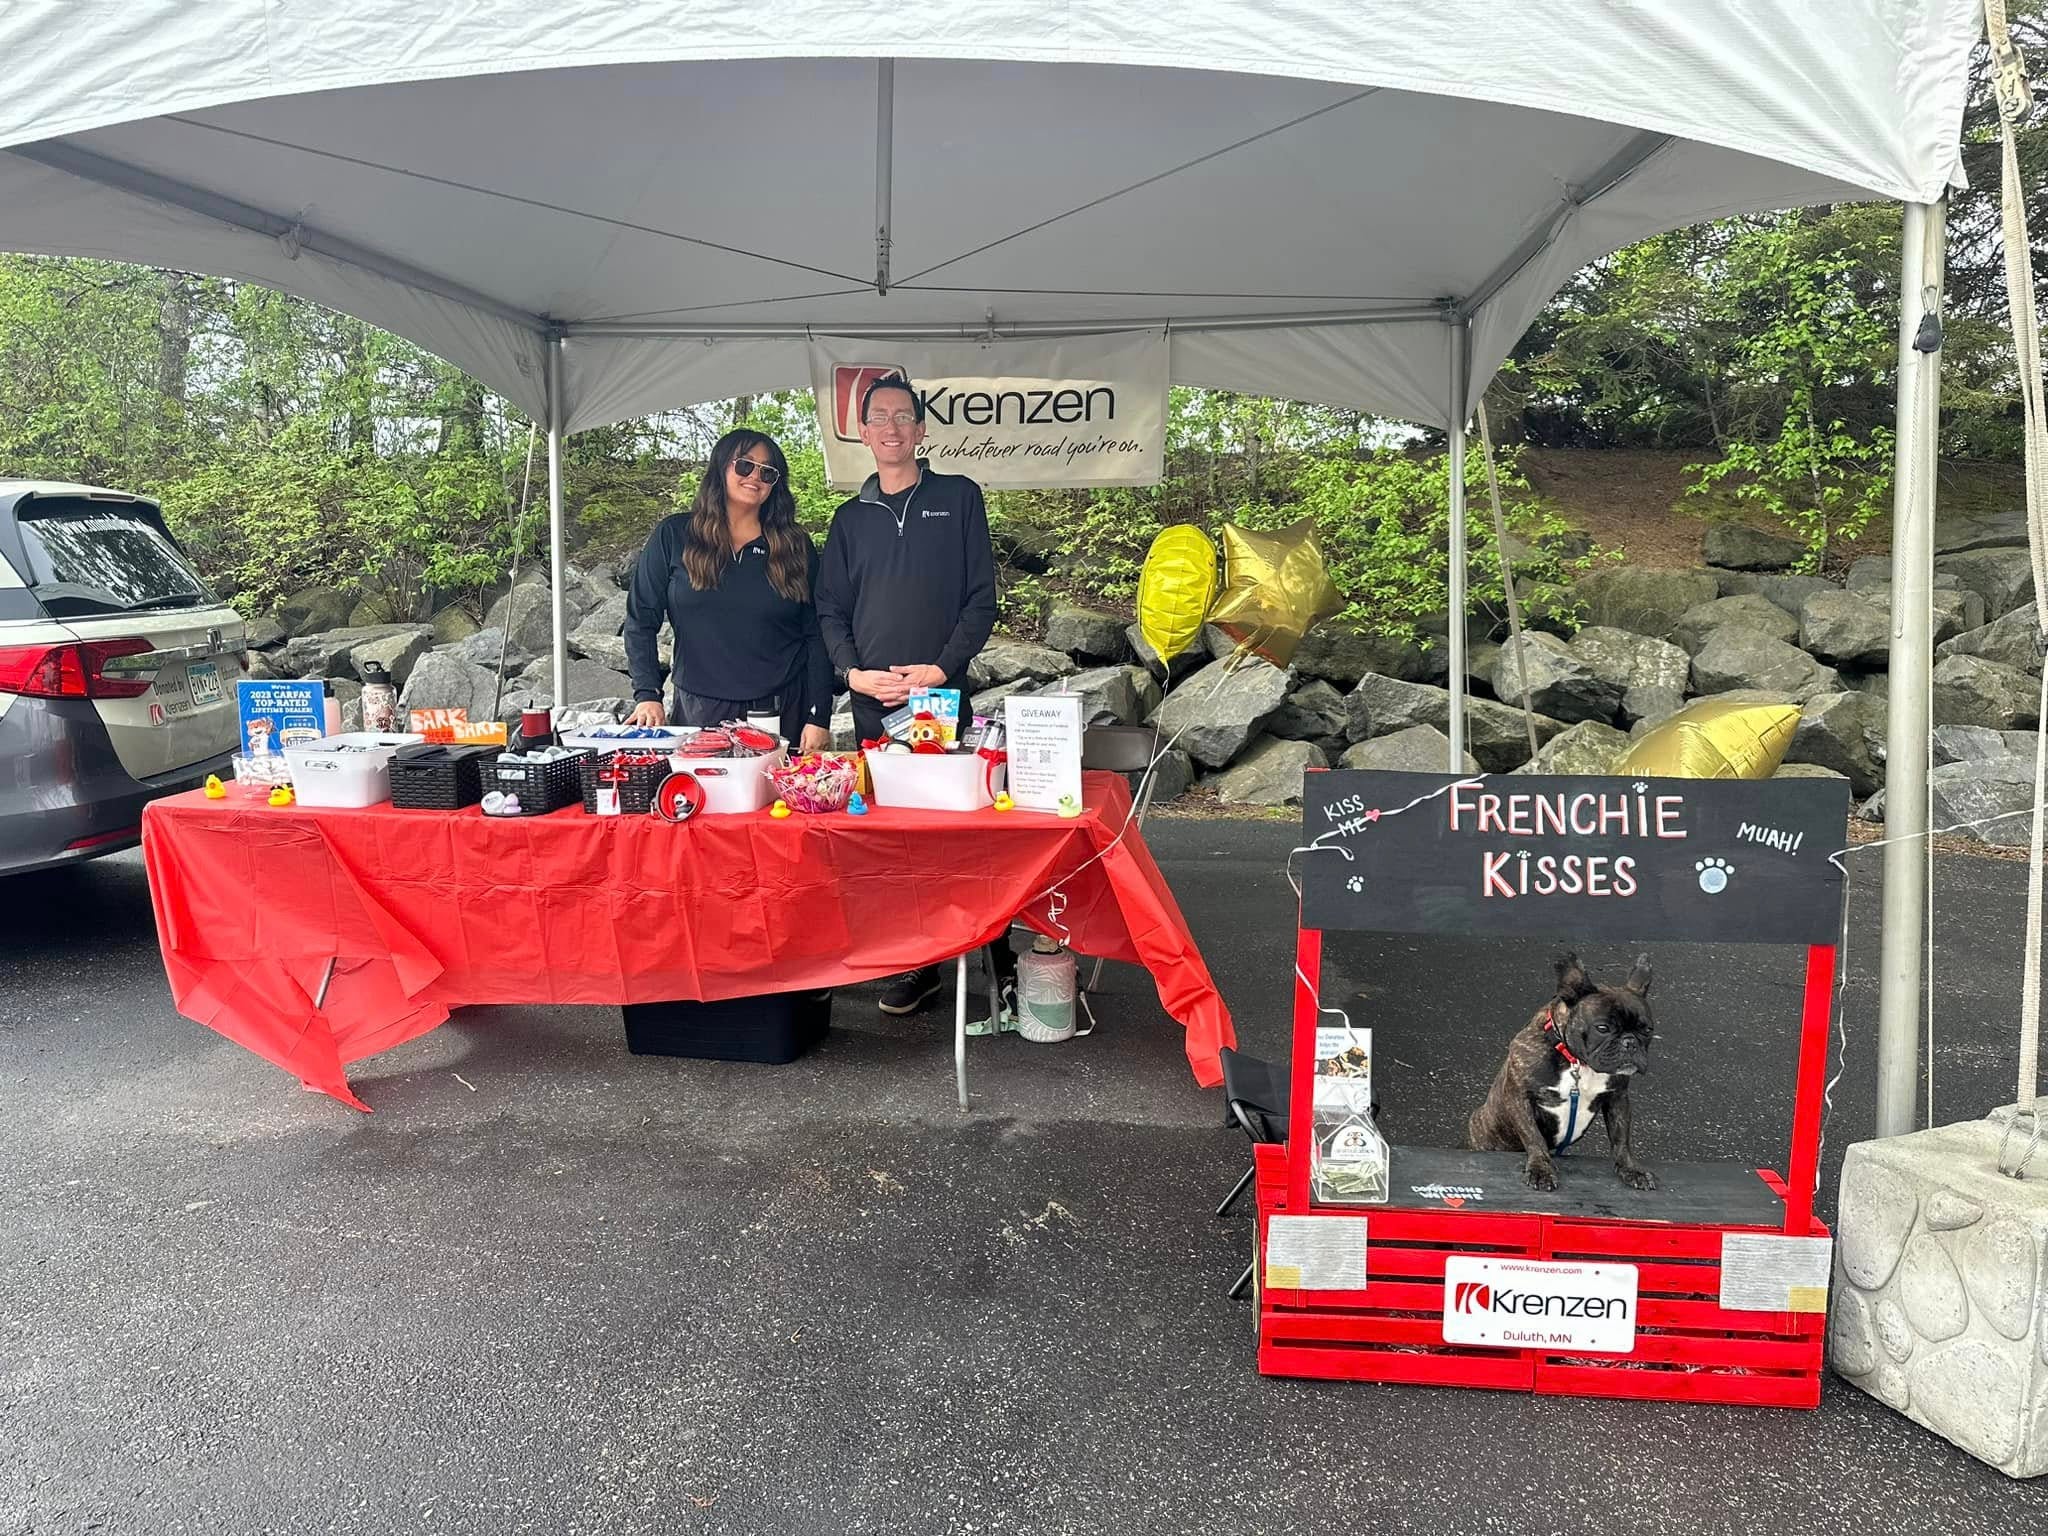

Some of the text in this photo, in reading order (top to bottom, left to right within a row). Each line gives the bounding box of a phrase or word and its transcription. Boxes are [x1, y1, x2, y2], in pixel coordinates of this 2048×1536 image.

[920, 387, 1115, 425] Krenzen
[916, 435, 1144, 465] or whatever road you're on.
[250, 691, 312, 699] 2023 CARFAX
[255, 699, 309, 707] TOP-RATED
[912, 697, 952, 714] BARK
[1020, 708, 1062, 718] GIVEAWAY
[1323, 794, 1365, 821] KISS
[1450, 782, 1688, 839] FRENCHIE
[1736, 821, 1804, 856] MUAH!
[1483, 850, 1638, 898] KISSES
[1500, 1263, 1583, 1274] www.krenzen.com
[1492, 1288, 1627, 1320] Krenzen
[1503, 1330, 1573, 1344] Duluth, MN
